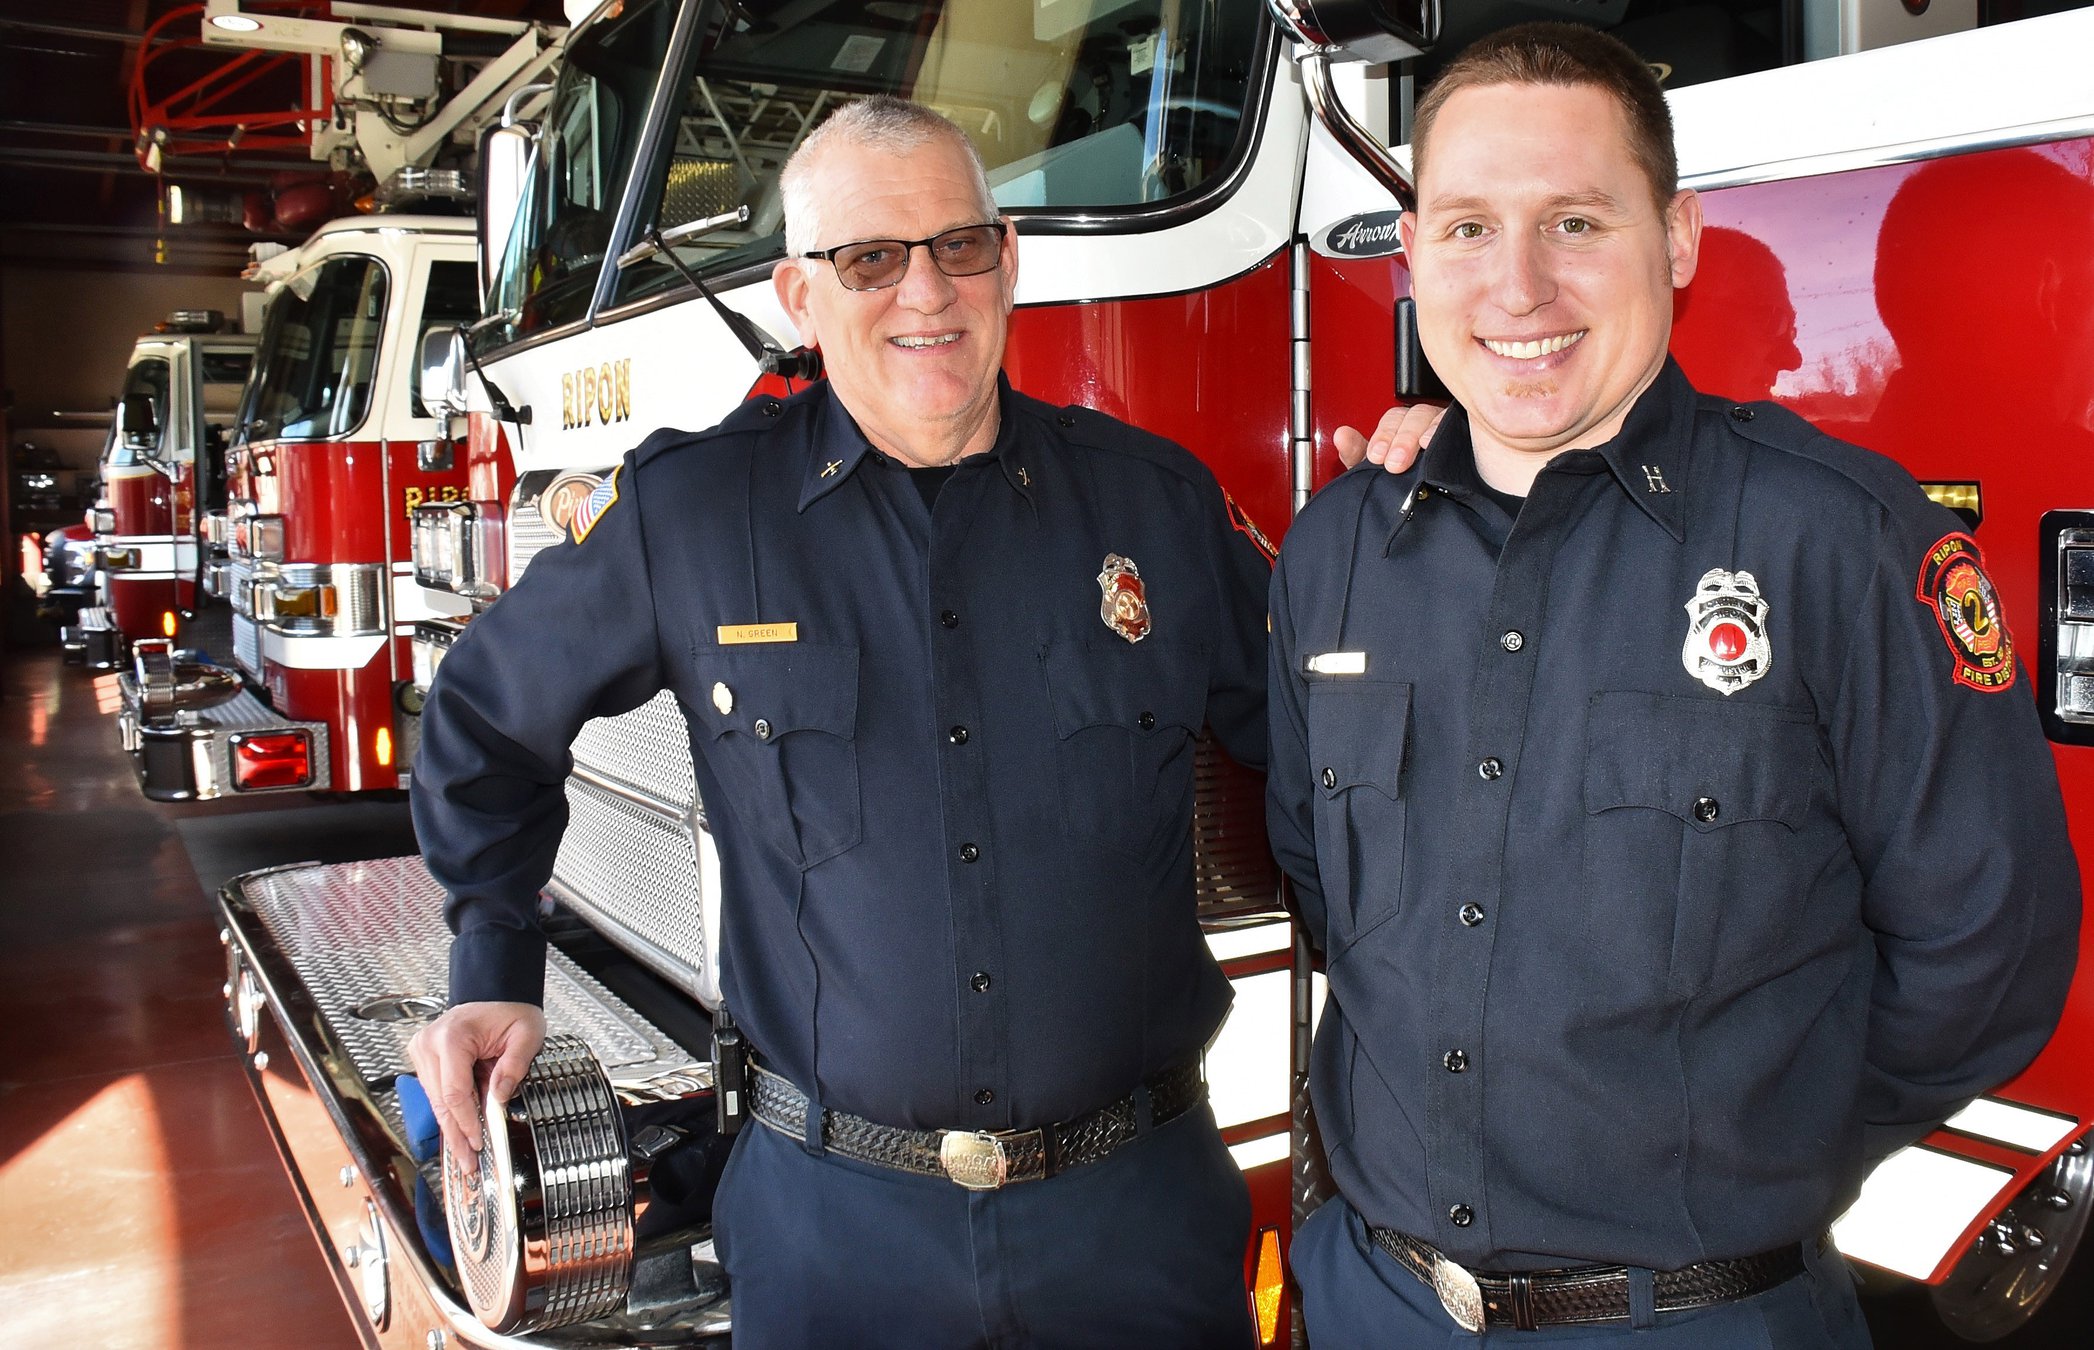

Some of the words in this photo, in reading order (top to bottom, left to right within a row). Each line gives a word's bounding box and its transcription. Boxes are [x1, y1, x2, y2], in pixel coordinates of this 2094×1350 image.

[562, 358, 631, 430] RIPON
[1933, 540, 1963, 565] RIPON
[1964, 591, 1989, 632] 2
[748, 629, 778, 638] GREEN
[1963, 667, 1992, 685] FIRE
